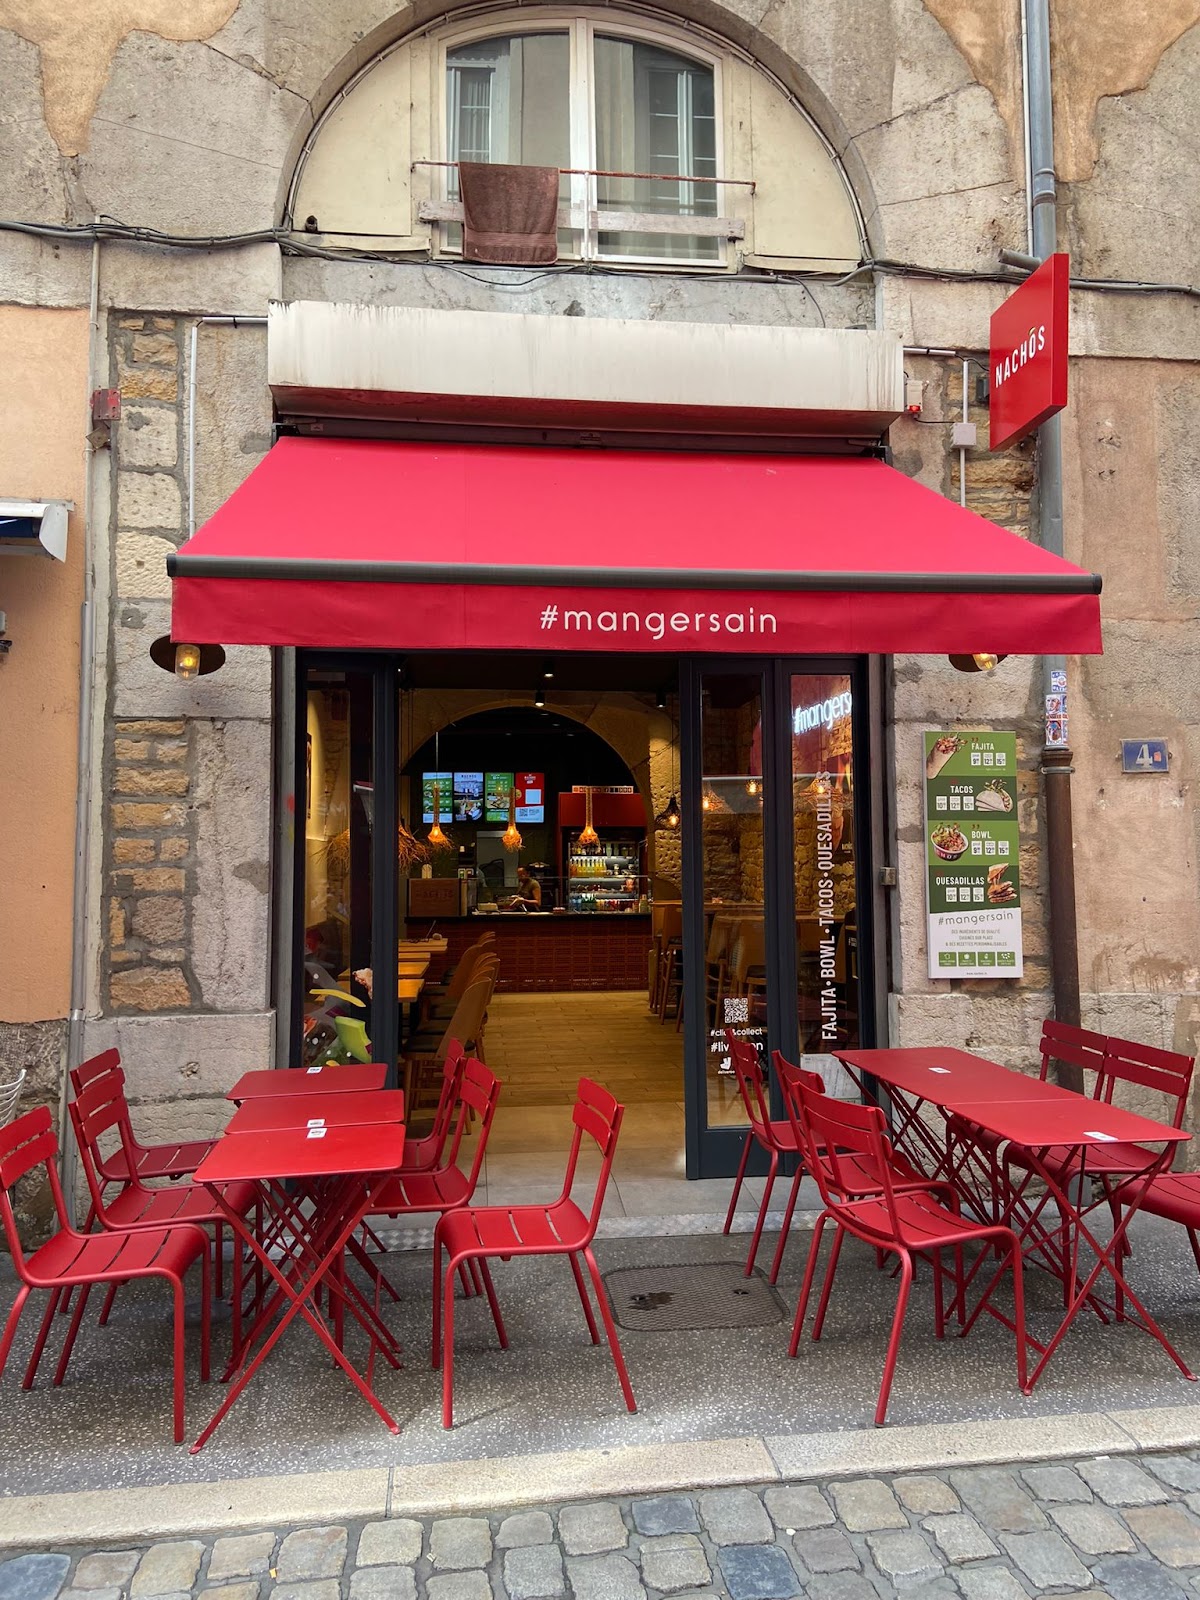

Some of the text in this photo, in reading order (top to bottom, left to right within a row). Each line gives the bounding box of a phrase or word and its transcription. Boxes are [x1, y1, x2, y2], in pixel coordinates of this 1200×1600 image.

[540, 604, 777, 640] #mangersain
[793, 691, 853, 734] #mangers
[1136, 744, 1153, 768] 4
[950, 786, 973, 794] TACOS
[936, 877, 984, 886] QUESADILLAS
[818, 879, 834, 926] TACOS
[938, 911, 1014, 925] #mangersain
[820, 936, 836, 978] BOWL
[821, 987, 838, 1040] FAJITA
[710, 1028, 762, 1036] #cli&collect
[710, 1042, 764, 1052] #livn
